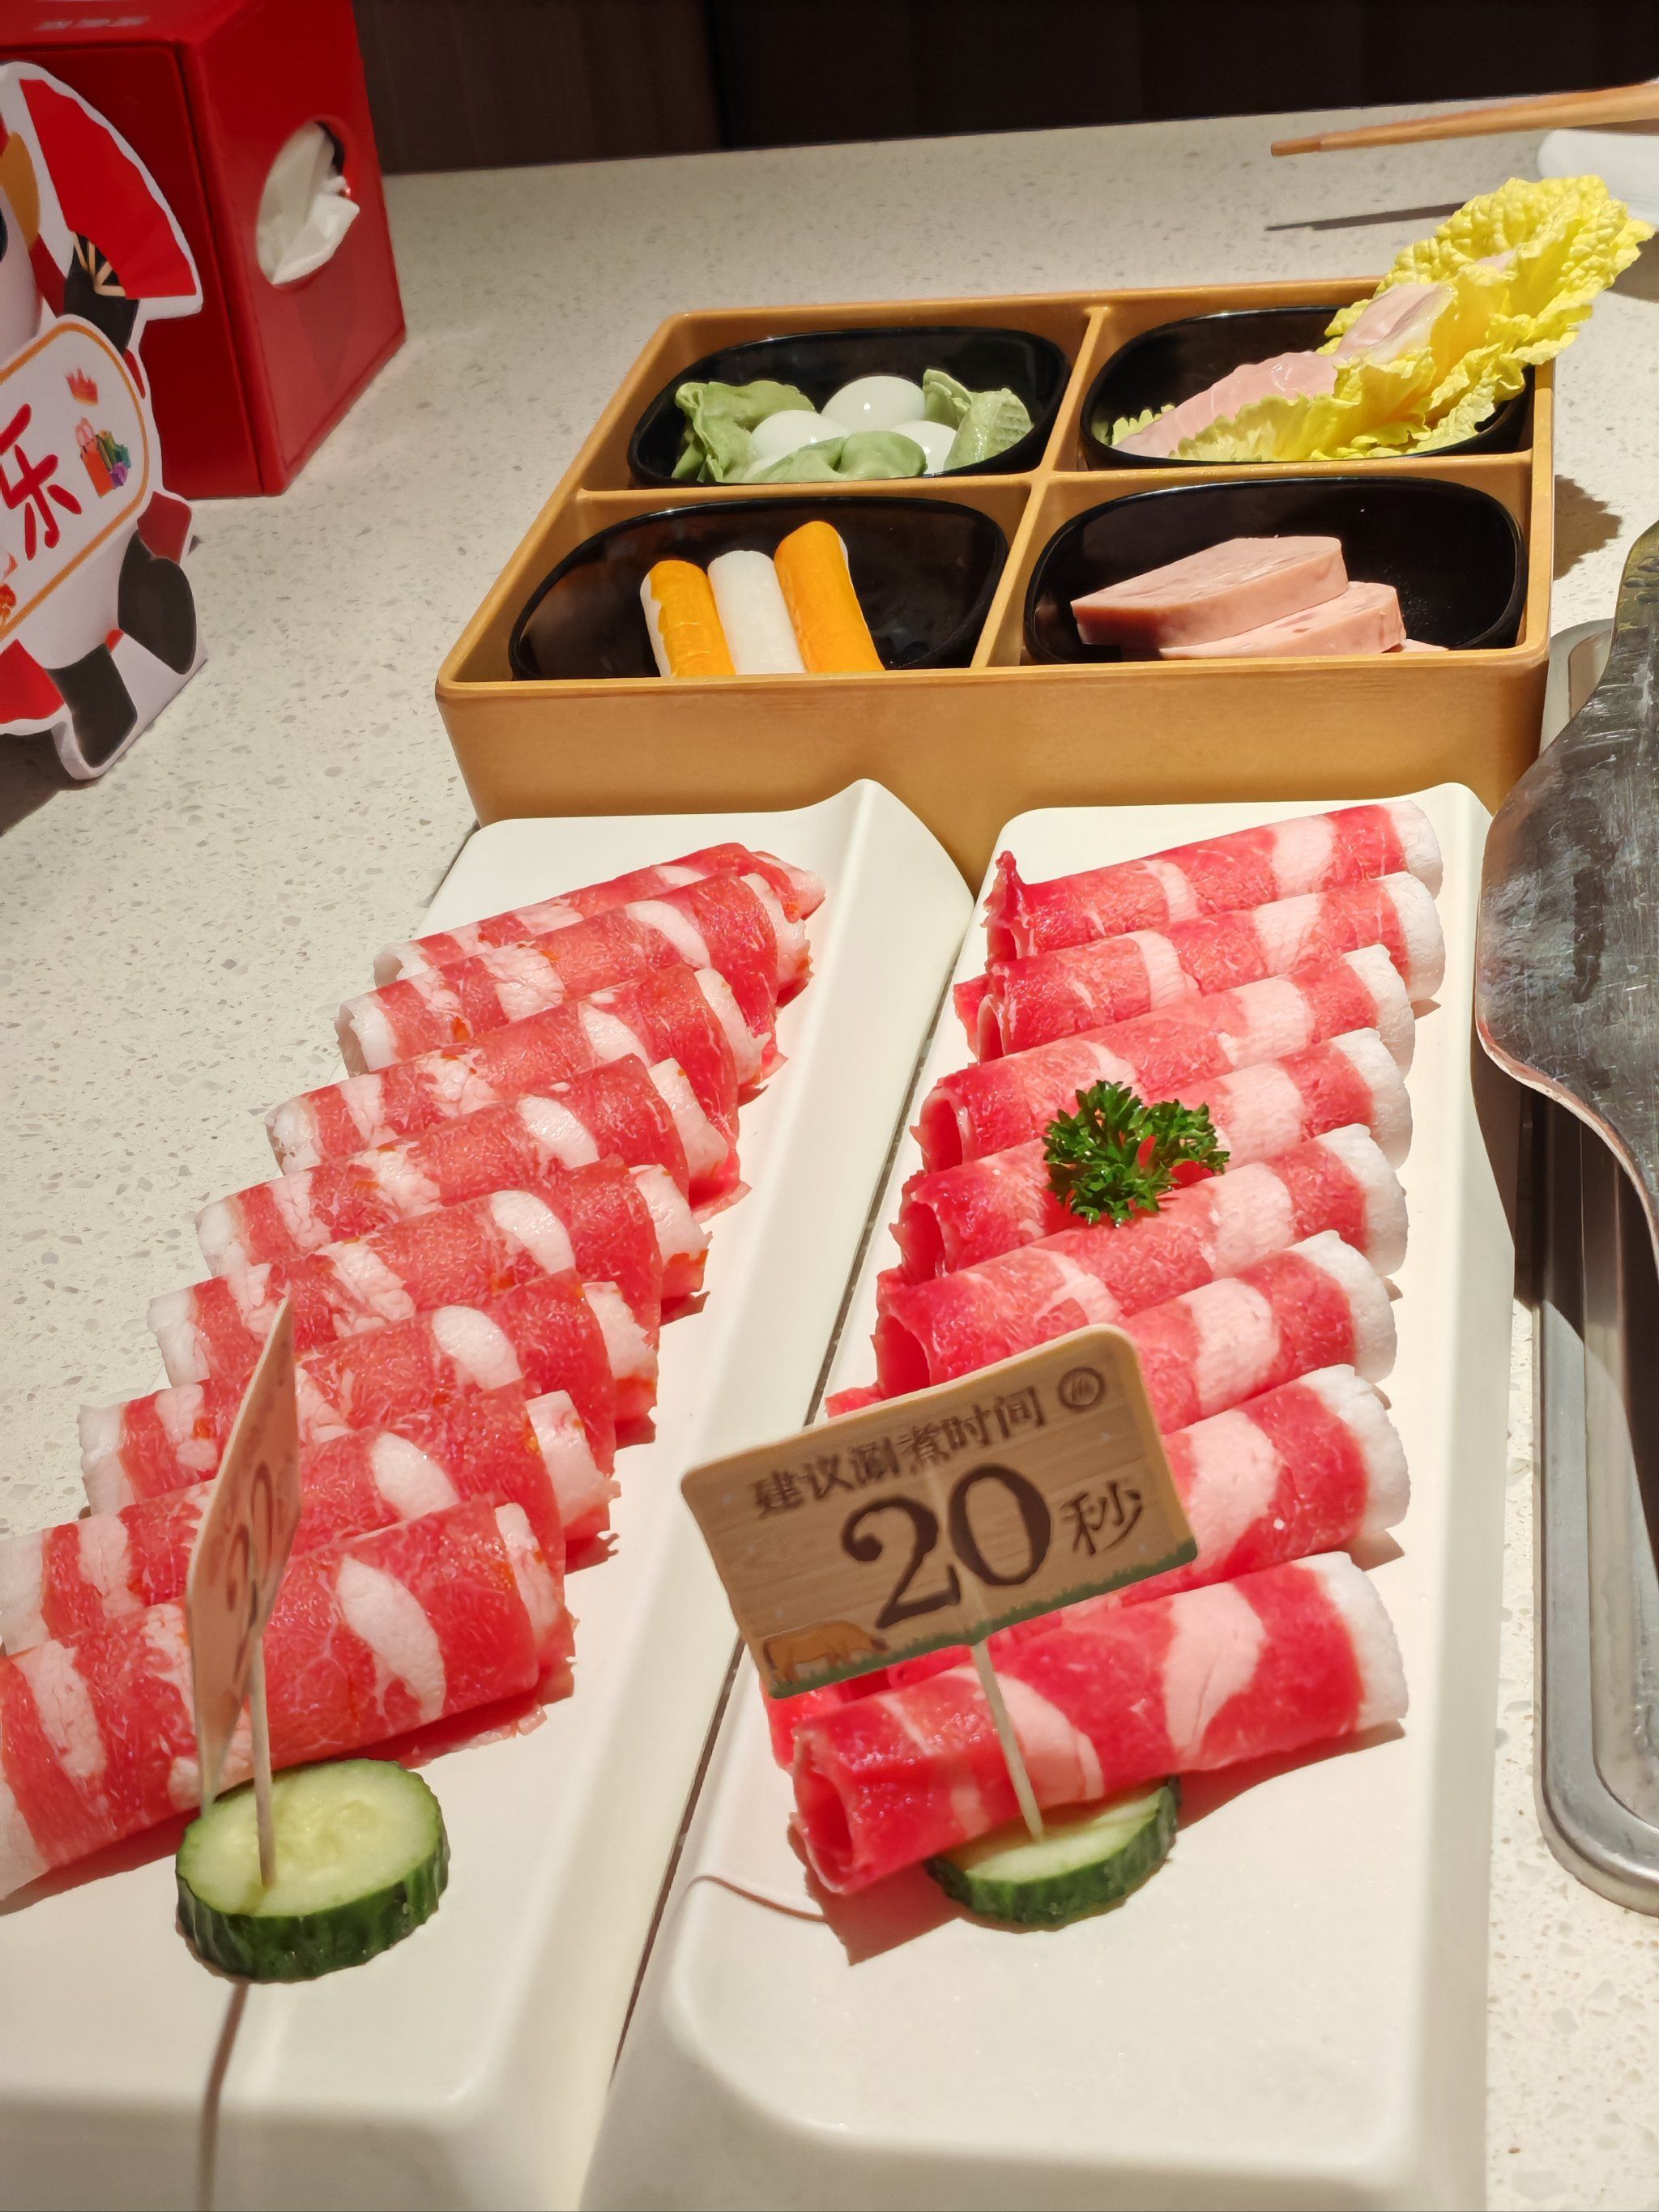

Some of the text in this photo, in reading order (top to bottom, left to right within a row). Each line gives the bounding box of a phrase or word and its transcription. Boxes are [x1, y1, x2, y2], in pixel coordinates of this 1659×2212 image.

[0, 403, 82, 560] 乐
[753, 1385, 1045, 1518] 建议涮煮时间
